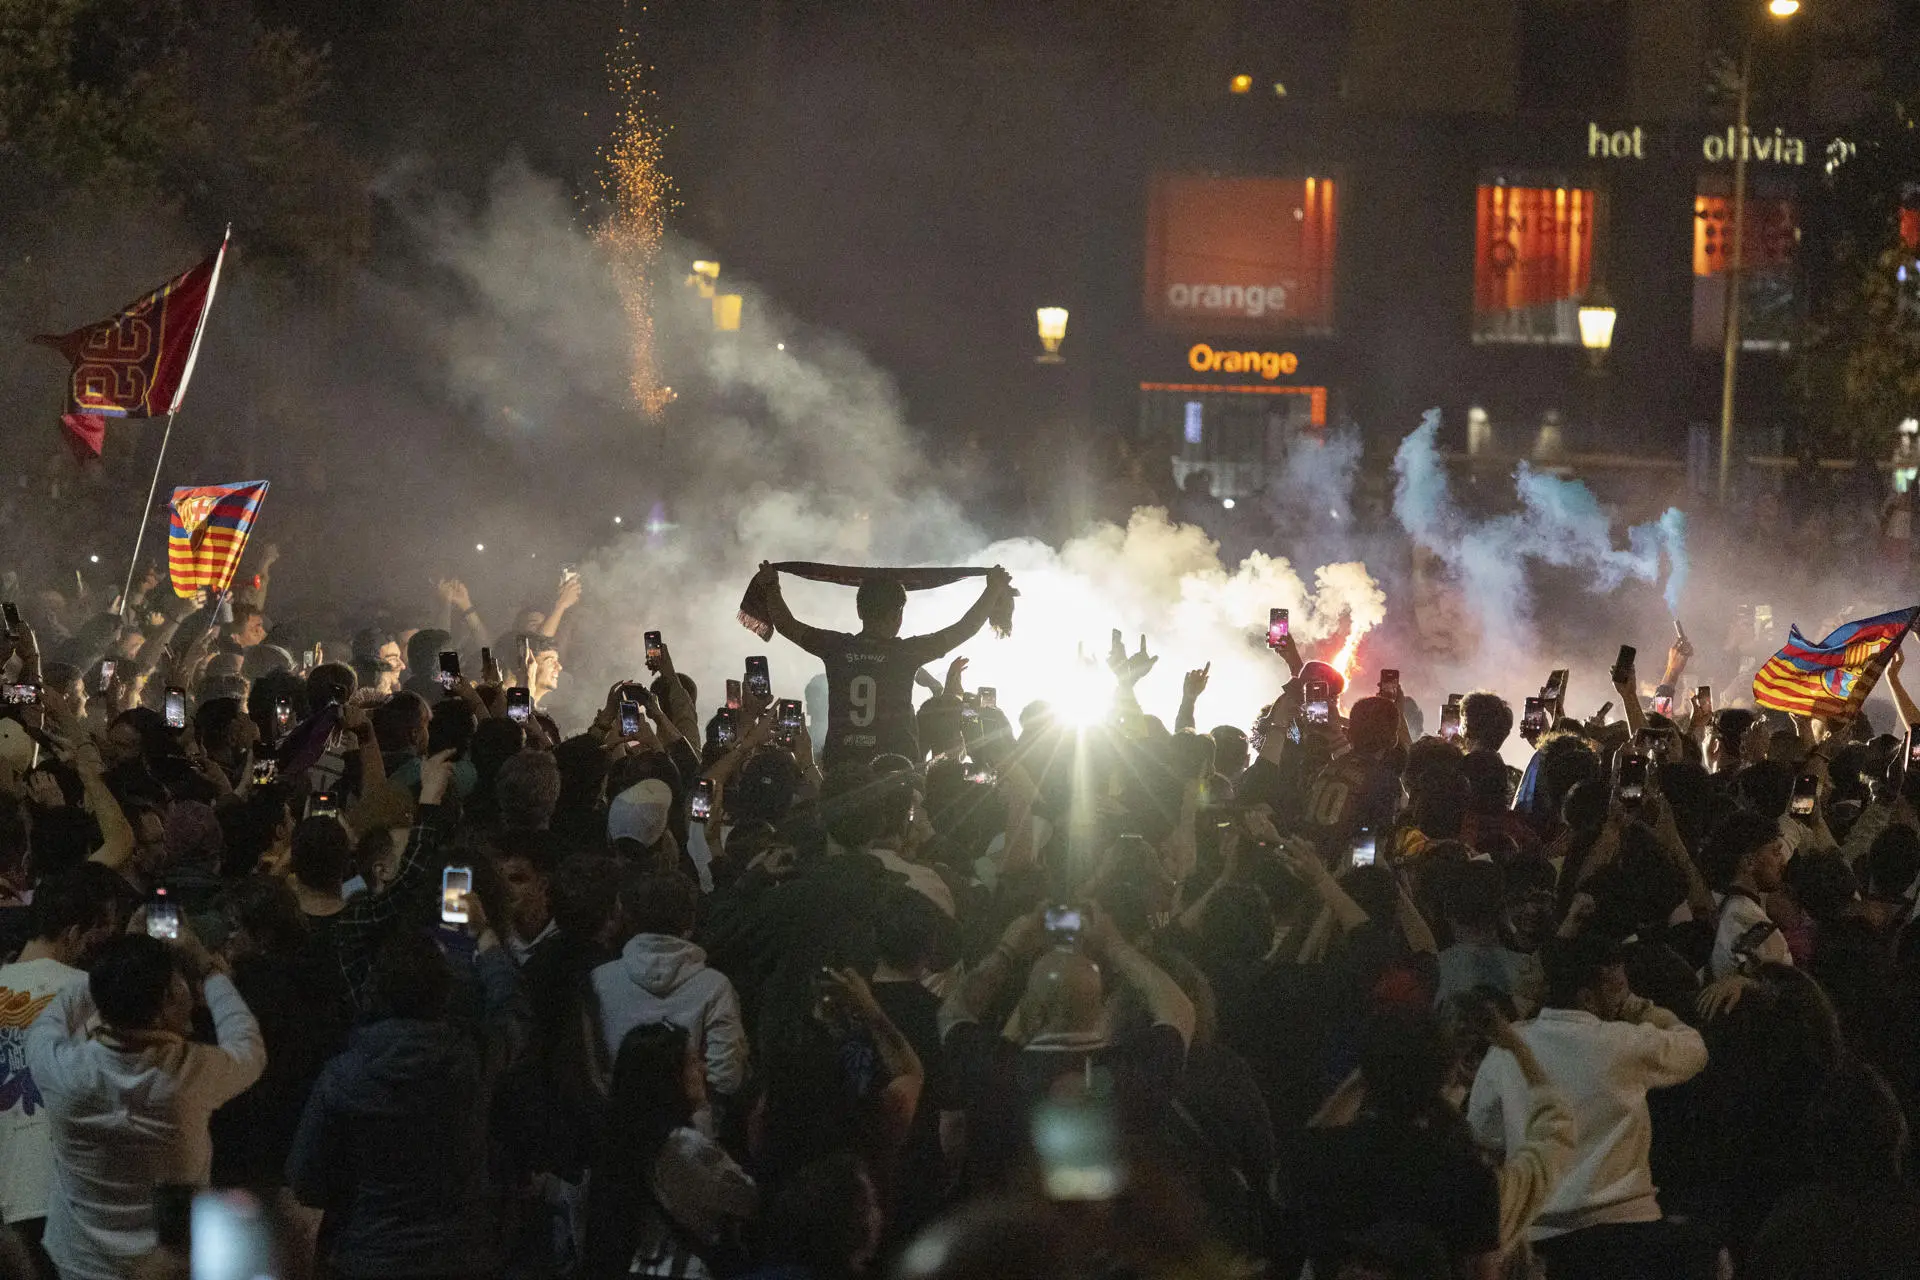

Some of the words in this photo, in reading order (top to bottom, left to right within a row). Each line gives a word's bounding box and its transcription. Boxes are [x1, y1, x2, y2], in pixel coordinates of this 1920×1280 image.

[1588, 122, 1645, 160] hot
[1702, 125, 1805, 165] olivia
[1168, 282, 1286, 316] orange
[1188, 343, 1298, 380] Orange
[850, 675, 877, 727] 9
